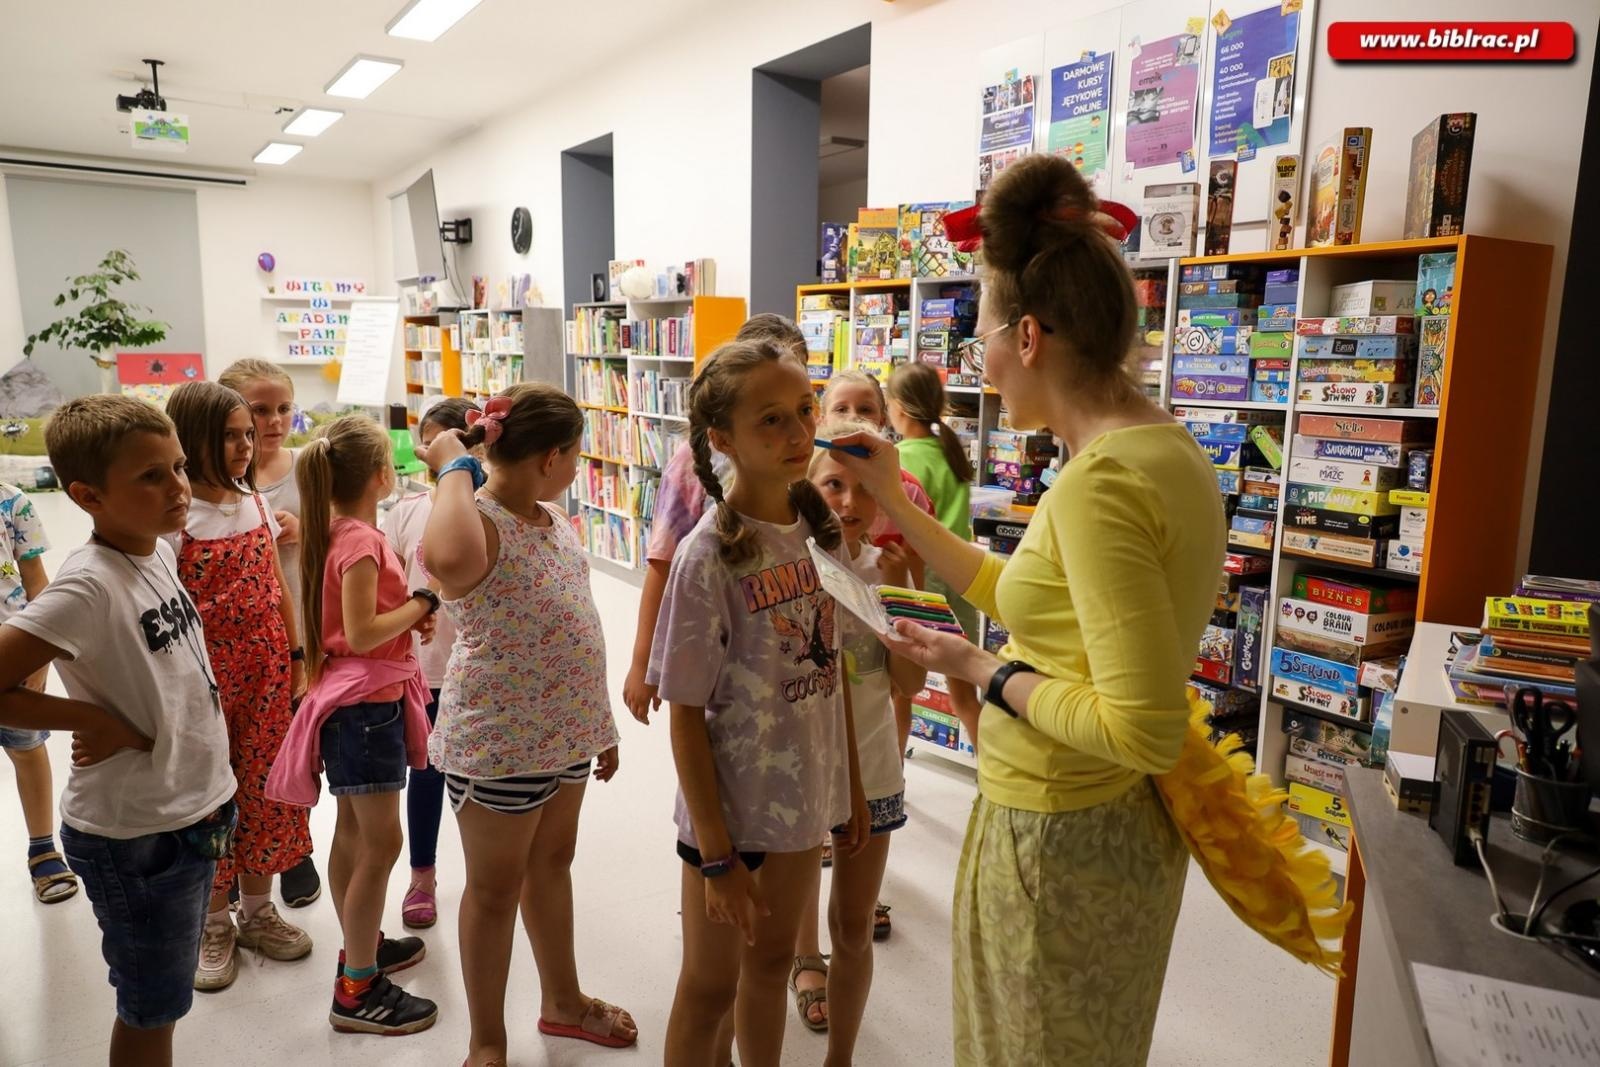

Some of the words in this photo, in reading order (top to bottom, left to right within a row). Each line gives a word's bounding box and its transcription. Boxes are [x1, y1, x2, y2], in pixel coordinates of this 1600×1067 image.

[1230, 42, 1245, 52] 000
[1063, 61, 1105, 81] DARMOWE
[1230, 63, 1244, 72] 000
[1270, 63, 1293, 78] KIN
[1077, 74, 1104, 90] KURSY
[1138, 71, 1162, 86] empik
[1061, 87, 1103, 108] JĘZYKOWE
[1072, 100, 1102, 116] ONLINE
[1276, 165, 1297, 173] BLOCK
[286, 280, 366, 293] WITAMY
[276, 312, 350, 325] AKADEM
[300, 328, 347, 340] PANA
[1189, 335, 1201, 347] CV
[288, 345, 346, 356] KLEKS
[1335, 421, 1364, 433] Stella
[1320, 470, 1345, 481] MAZE
[1295, 515, 1318, 525] TIME
[998, 526, 1025, 538] abalon
[739, 558, 824, 614] RAMO
[1312, 588, 1362, 606] BIZNES
[140, 589, 203, 655] ESSA
[1325, 611, 1352, 623] COLOUR
[1323, 619, 1352, 632] BRAIN
[1280, 651, 1293, 674] 5
[1332, 797, 1342, 811] 5
